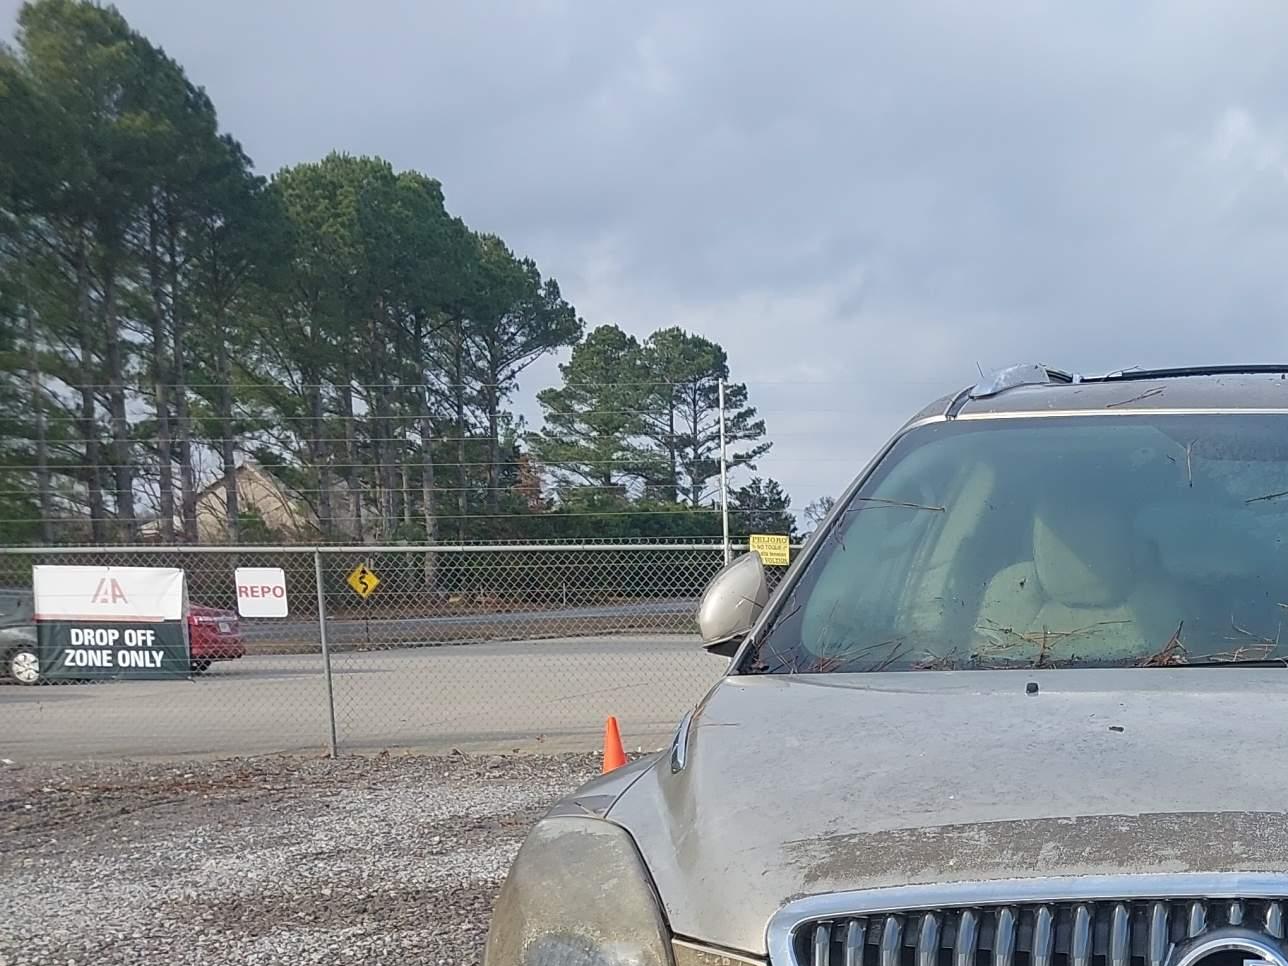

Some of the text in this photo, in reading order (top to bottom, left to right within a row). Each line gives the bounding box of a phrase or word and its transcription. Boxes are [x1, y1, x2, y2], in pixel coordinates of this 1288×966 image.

[238, 585, 285, 599] REPO
[71, 629, 156, 647] DROP OFF
[64, 649, 164, 668] ZONE ONLY
